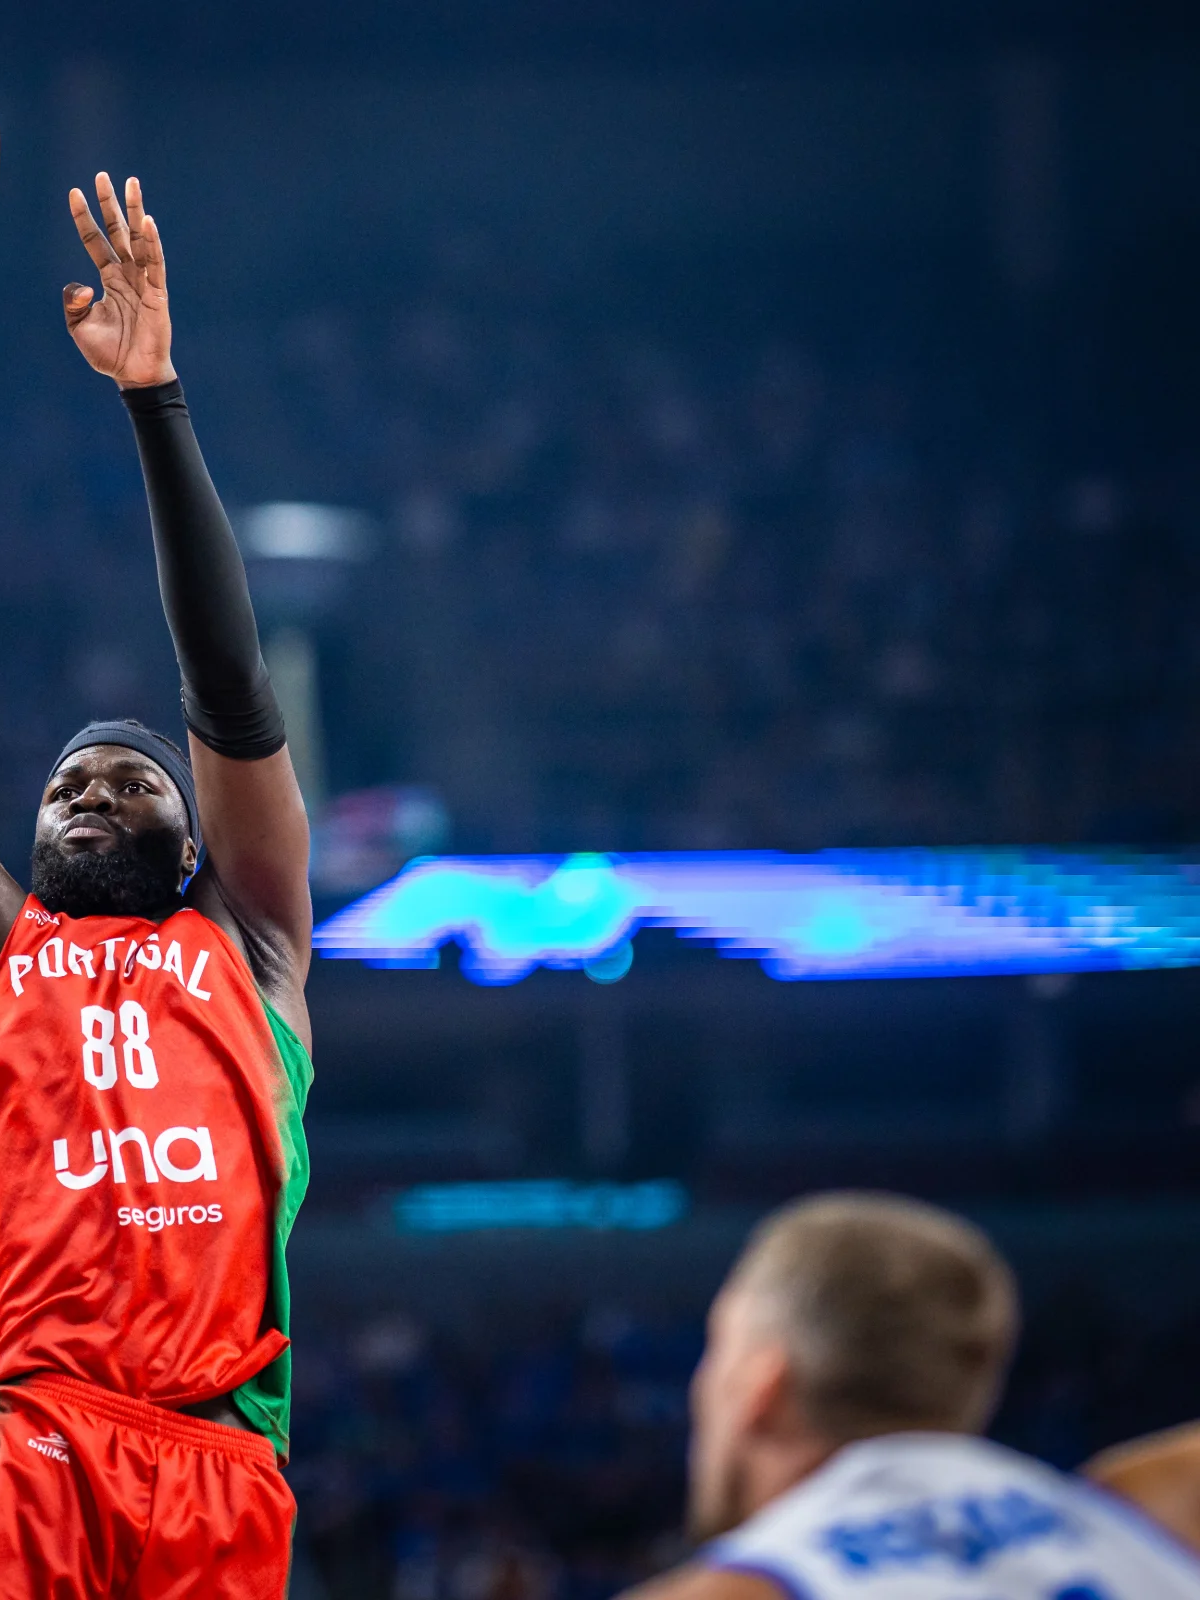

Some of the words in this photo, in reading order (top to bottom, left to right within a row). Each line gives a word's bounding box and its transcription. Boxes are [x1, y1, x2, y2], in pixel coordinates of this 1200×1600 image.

[81, 1000, 160, 1090] 88
[53, 1126, 218, 1190] una
[118, 1203, 223, 1232] seguros
